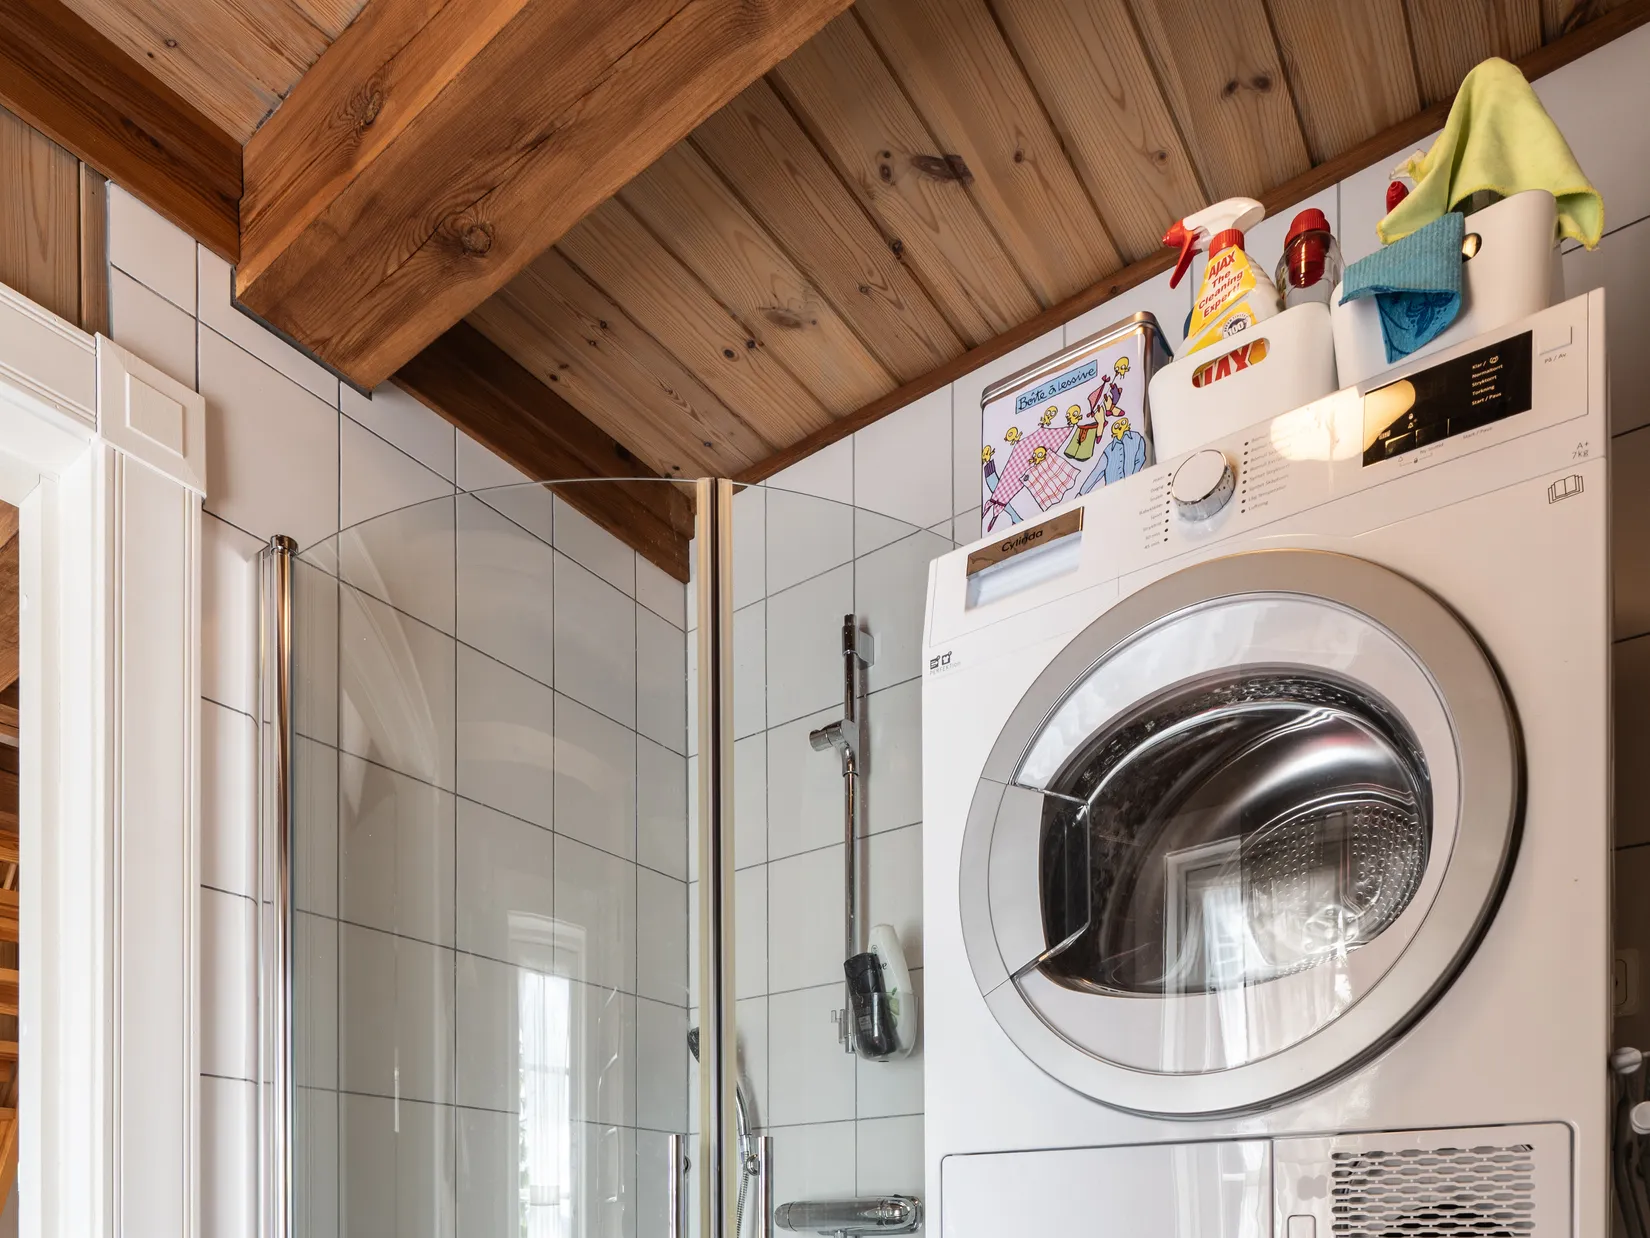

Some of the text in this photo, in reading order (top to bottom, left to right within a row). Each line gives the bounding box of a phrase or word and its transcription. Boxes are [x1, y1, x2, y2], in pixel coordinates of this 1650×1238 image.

[1208, 250, 1236, 280] AJAX
[1212, 270, 1231, 288] The
[1198, 270, 1244, 310] Cleaning
[1203, 283, 1241, 318] Expert!
[1019, 390, 1047, 410] Boîte
[1472, 397, 1485, 406] Start
[1576, 441, 1589, 450] A+
[1001, 529, 1044, 552] Cylinda
